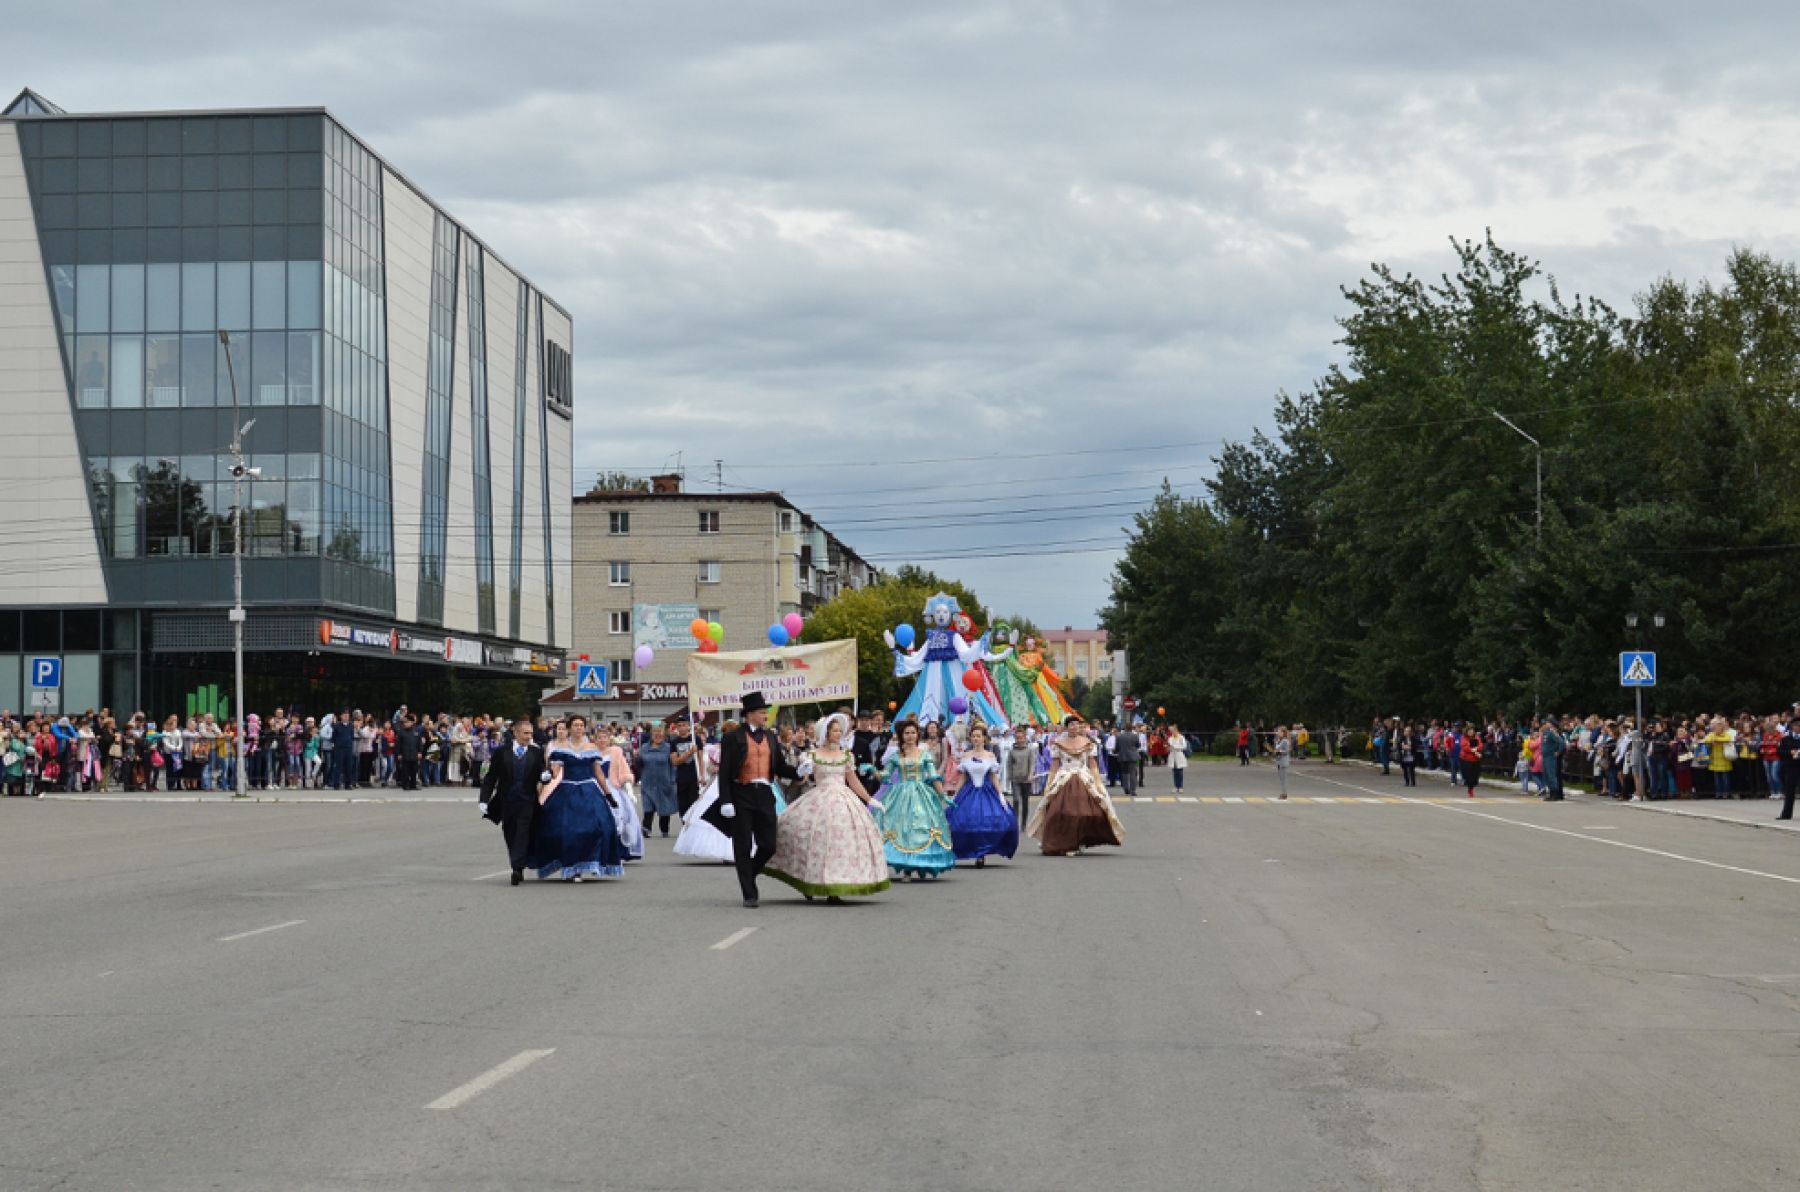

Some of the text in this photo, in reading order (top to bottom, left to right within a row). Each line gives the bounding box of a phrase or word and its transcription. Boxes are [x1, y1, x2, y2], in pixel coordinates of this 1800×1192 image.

[38, 662, 52, 684] P
[743, 674, 806, 691] БИЙСКИЙ
[641, 683, 688, 700] КОЖА
